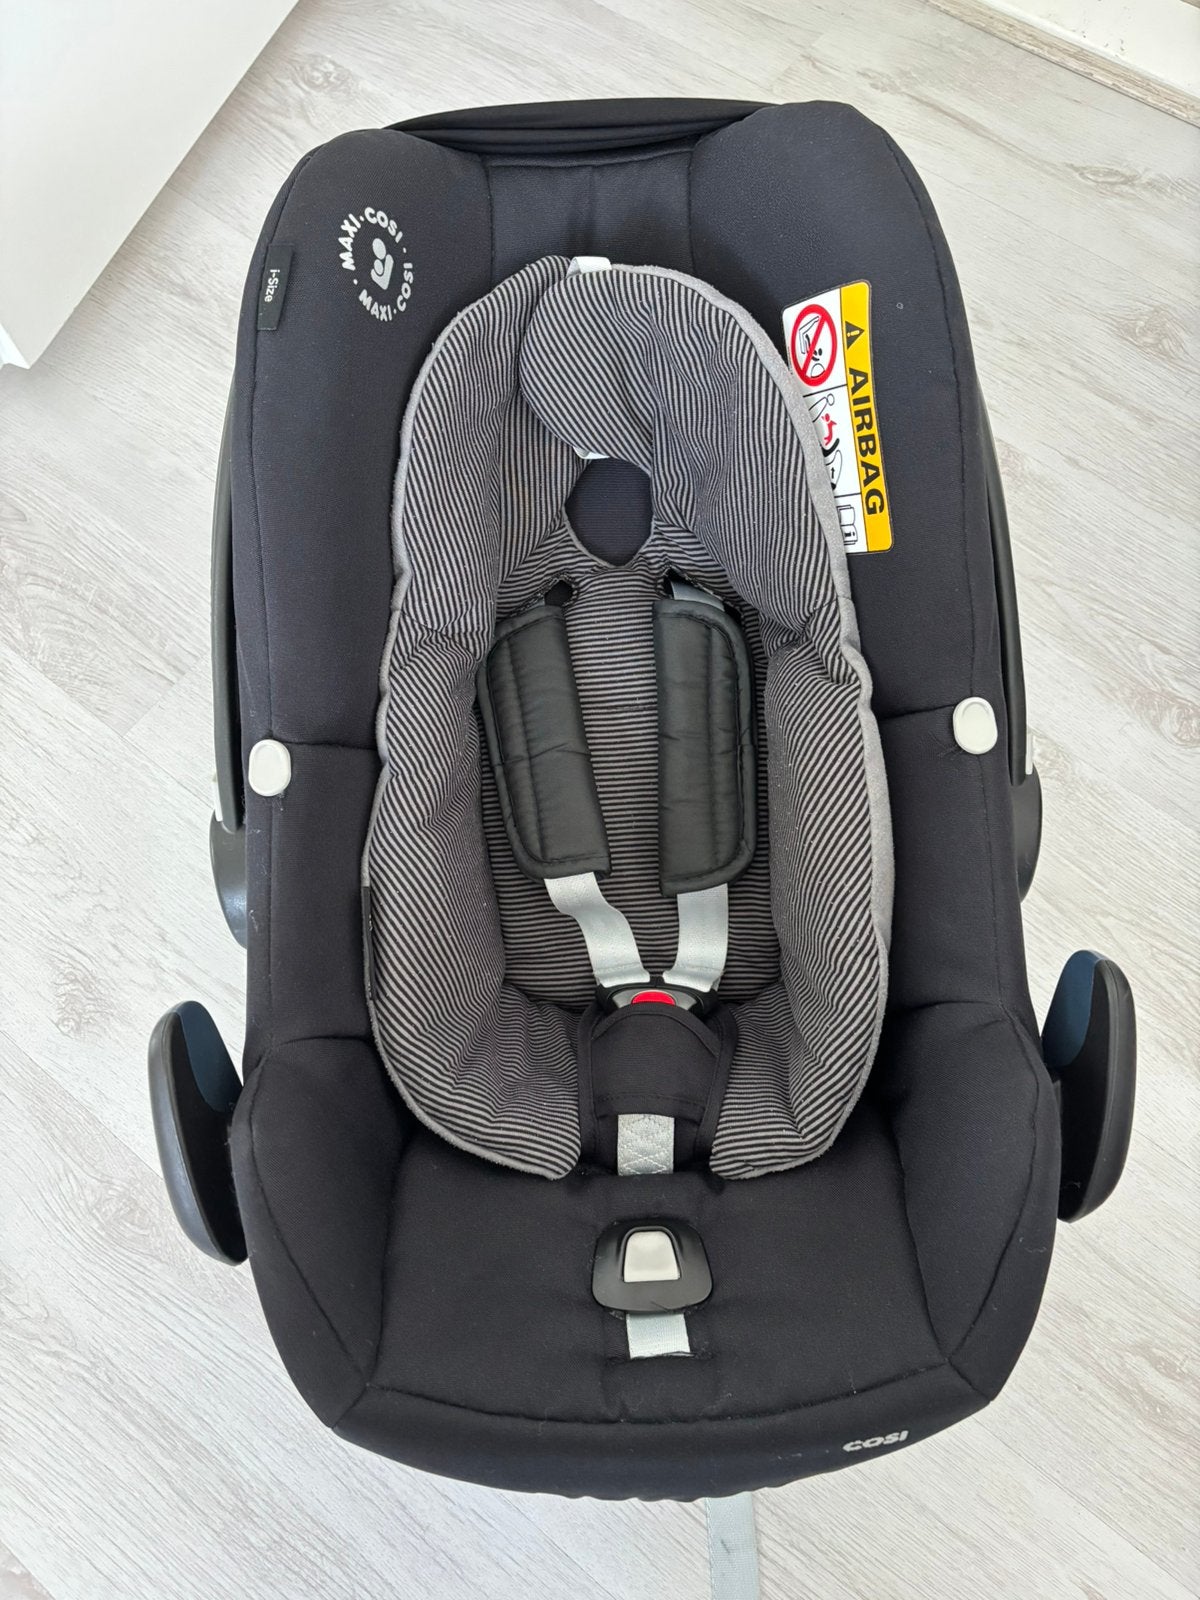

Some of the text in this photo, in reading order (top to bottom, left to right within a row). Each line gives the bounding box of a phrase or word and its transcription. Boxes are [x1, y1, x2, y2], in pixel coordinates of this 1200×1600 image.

[264, 269, 280, 302] i-Size
[849, 367, 885, 515] AIRBAG
[842, 1430, 909, 1452] COSI
